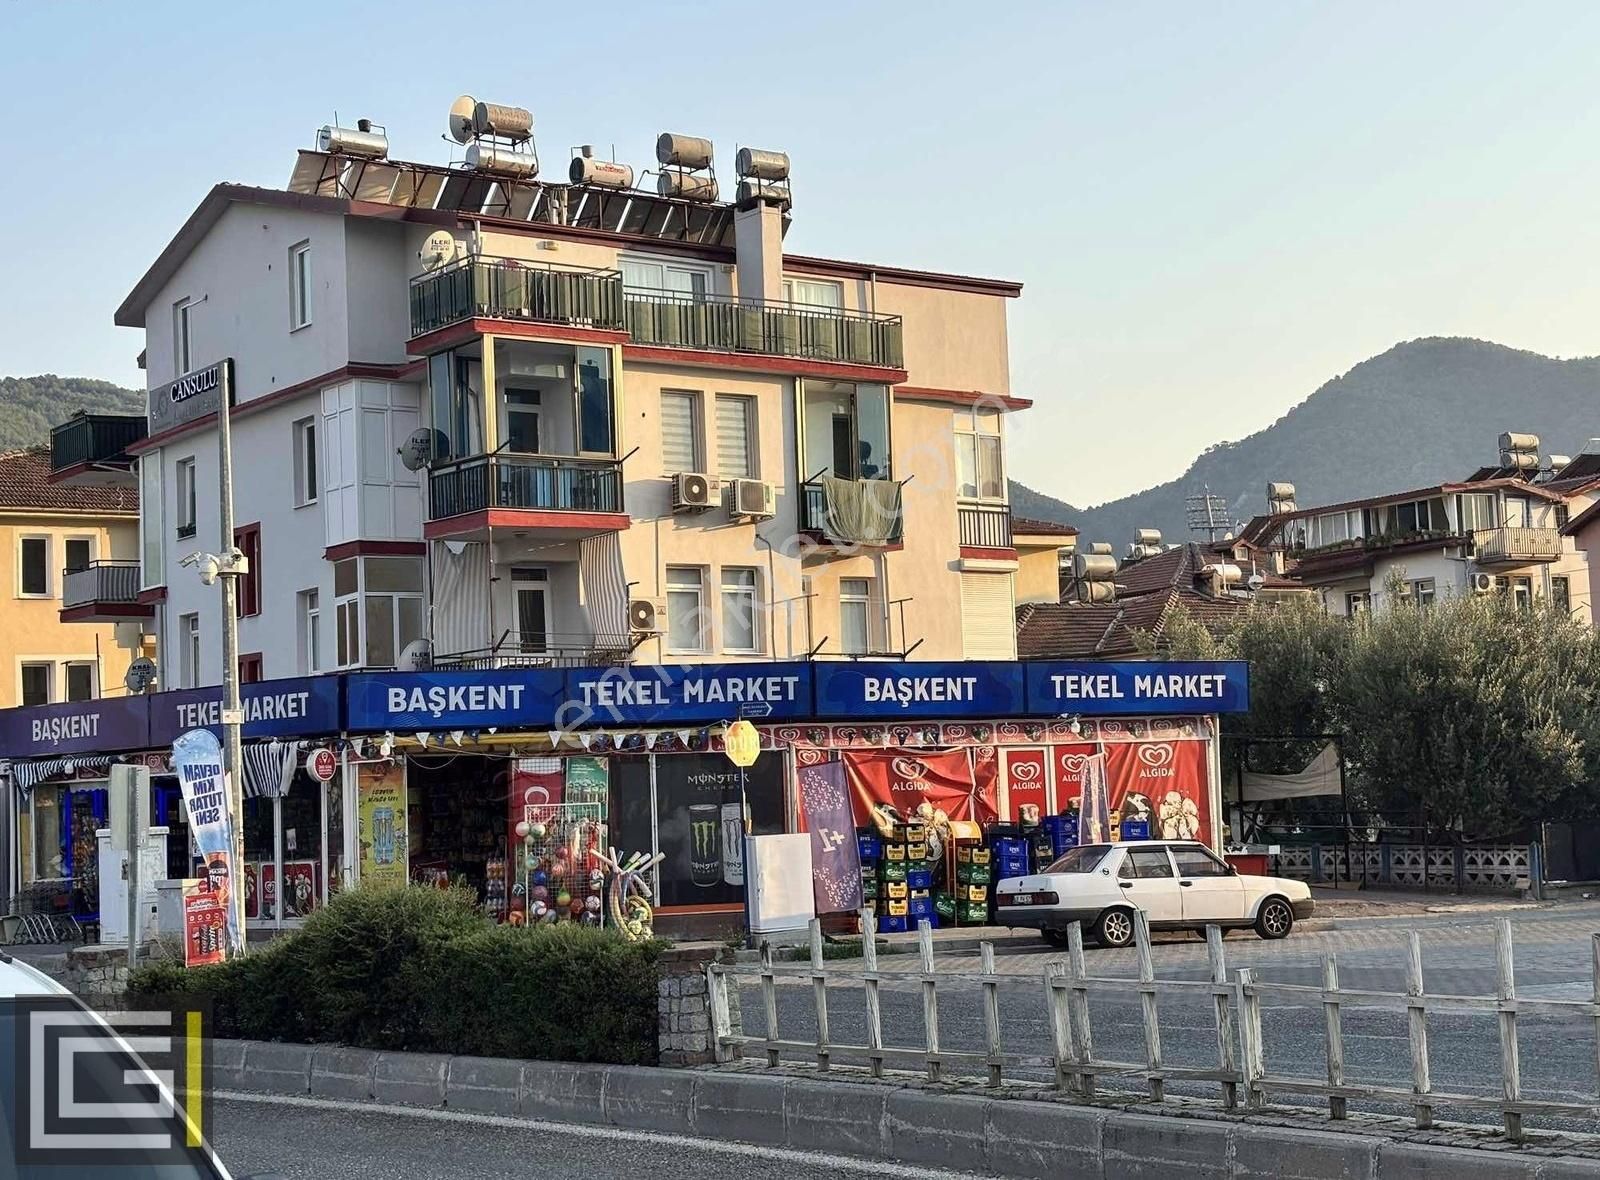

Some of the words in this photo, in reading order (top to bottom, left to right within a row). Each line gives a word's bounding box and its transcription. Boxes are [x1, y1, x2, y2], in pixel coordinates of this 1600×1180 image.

[170, 366, 219, 402] CANSULU
[388, 684, 525, 717] BAŞKENT
[578, 680, 670, 706] TEKEL
[684, 676, 799, 704] MARKET
[864, 677, 977, 707] BAŞKENT
[1051, 675, 1124, 698] TEKEL
[1134, 674, 1226, 698] MARKET
[240, 692, 309, 722] MARKET
[32, 713, 100, 745] BAŞKENT
[1062, 774, 1080, 782] ALGI
